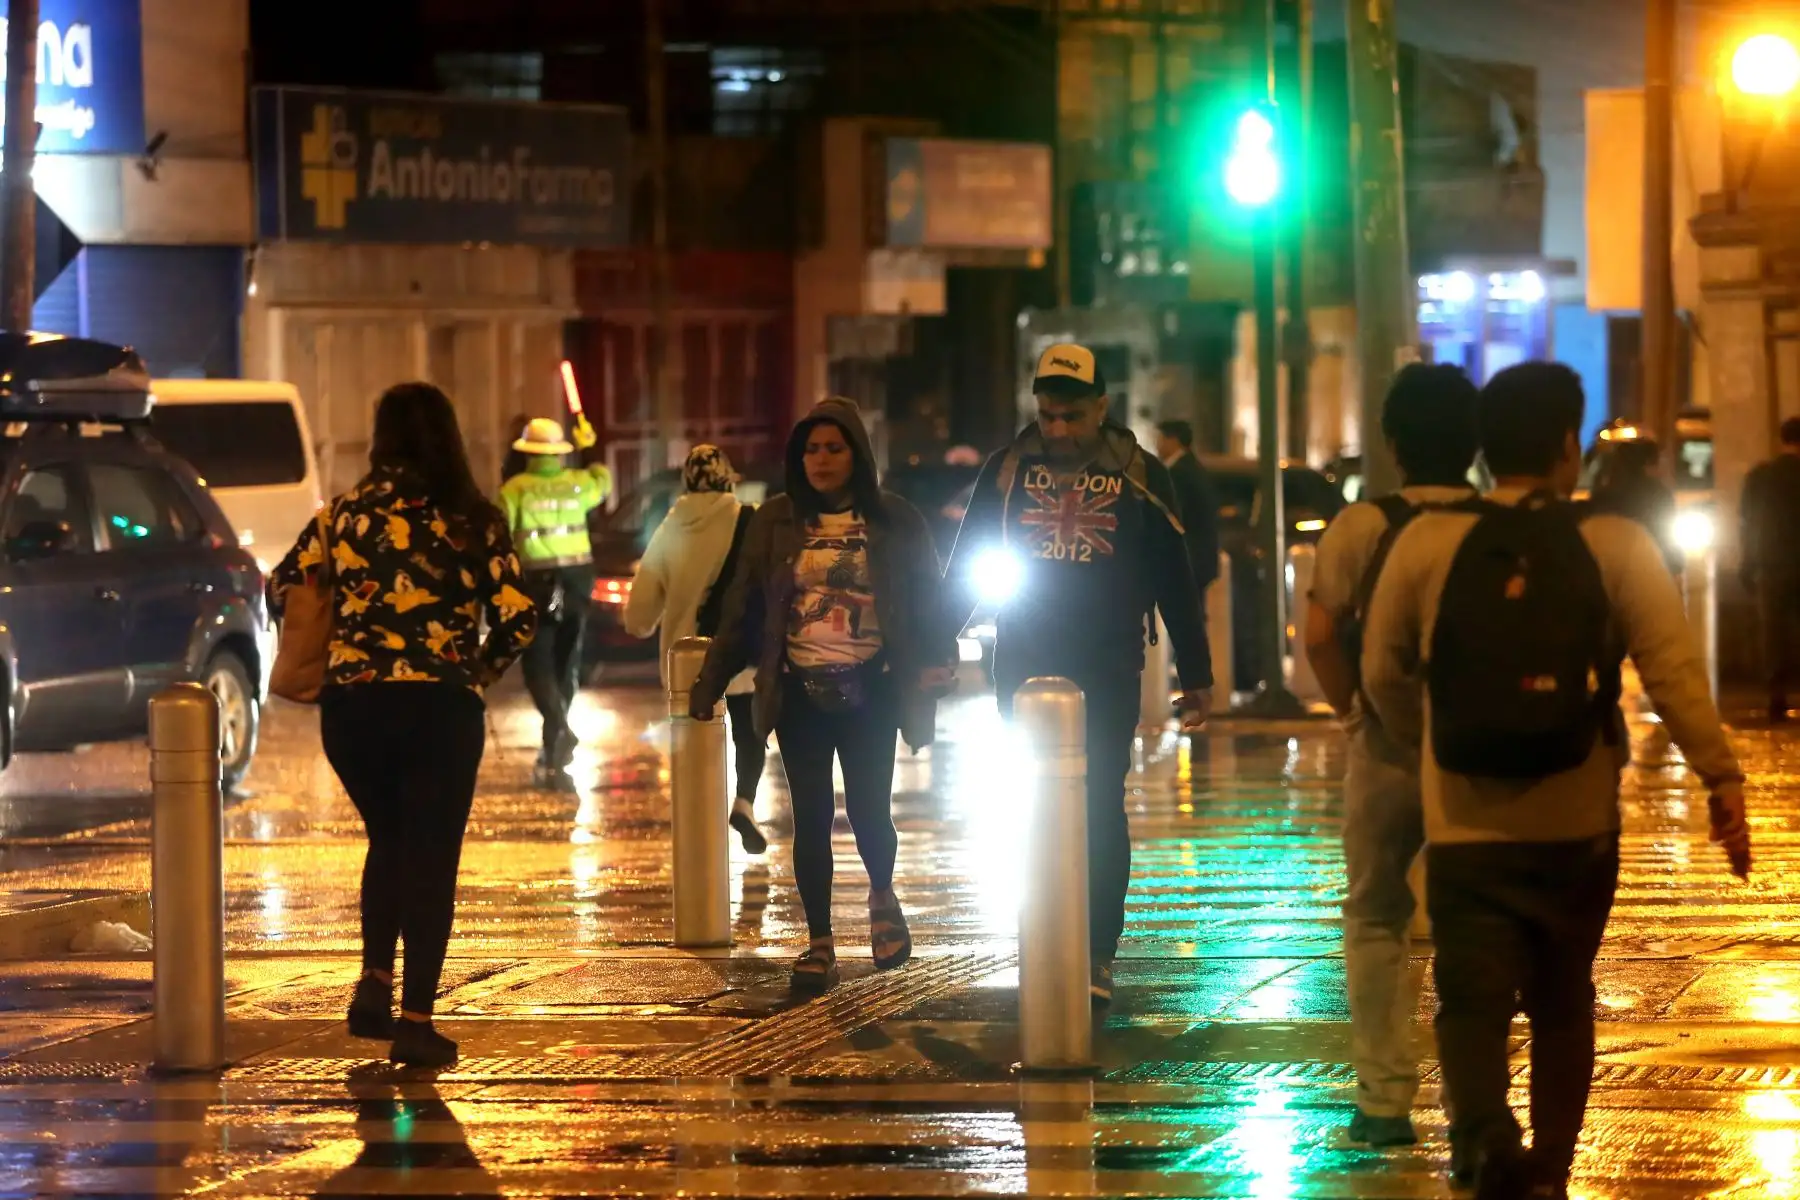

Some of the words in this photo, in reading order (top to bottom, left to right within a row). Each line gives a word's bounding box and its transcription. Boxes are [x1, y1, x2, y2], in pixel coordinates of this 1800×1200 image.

[367, 140, 614, 206] AntonioFarma
[1023, 469, 1122, 495] LODON
[1041, 541, 1092, 562] 2012
